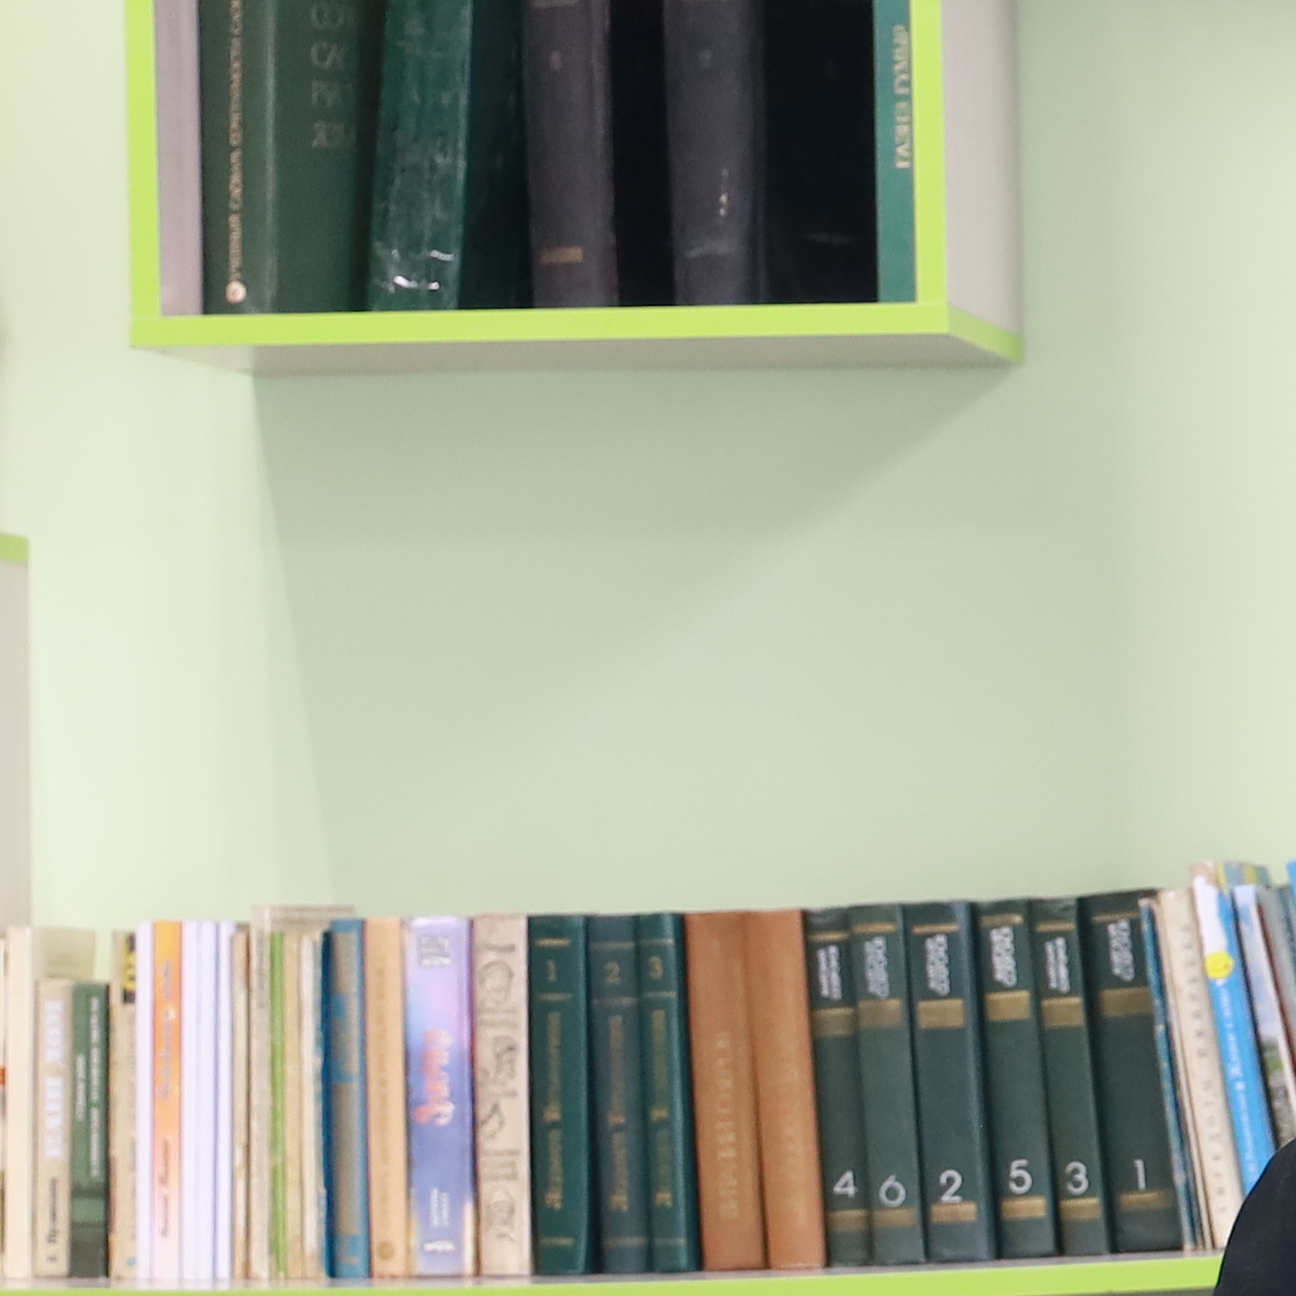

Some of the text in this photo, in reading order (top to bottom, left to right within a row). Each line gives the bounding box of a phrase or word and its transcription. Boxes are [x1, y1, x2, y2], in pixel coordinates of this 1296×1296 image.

[833, 1169, 858, 1199] 4
[879, 1174, 907, 1207] 6
[939, 1169, 963, 1203] 2
[1009, 1159, 1033, 1194] 5
[1065, 1161, 1090, 1196] 3
[1134, 1159, 1146, 1191] 1
